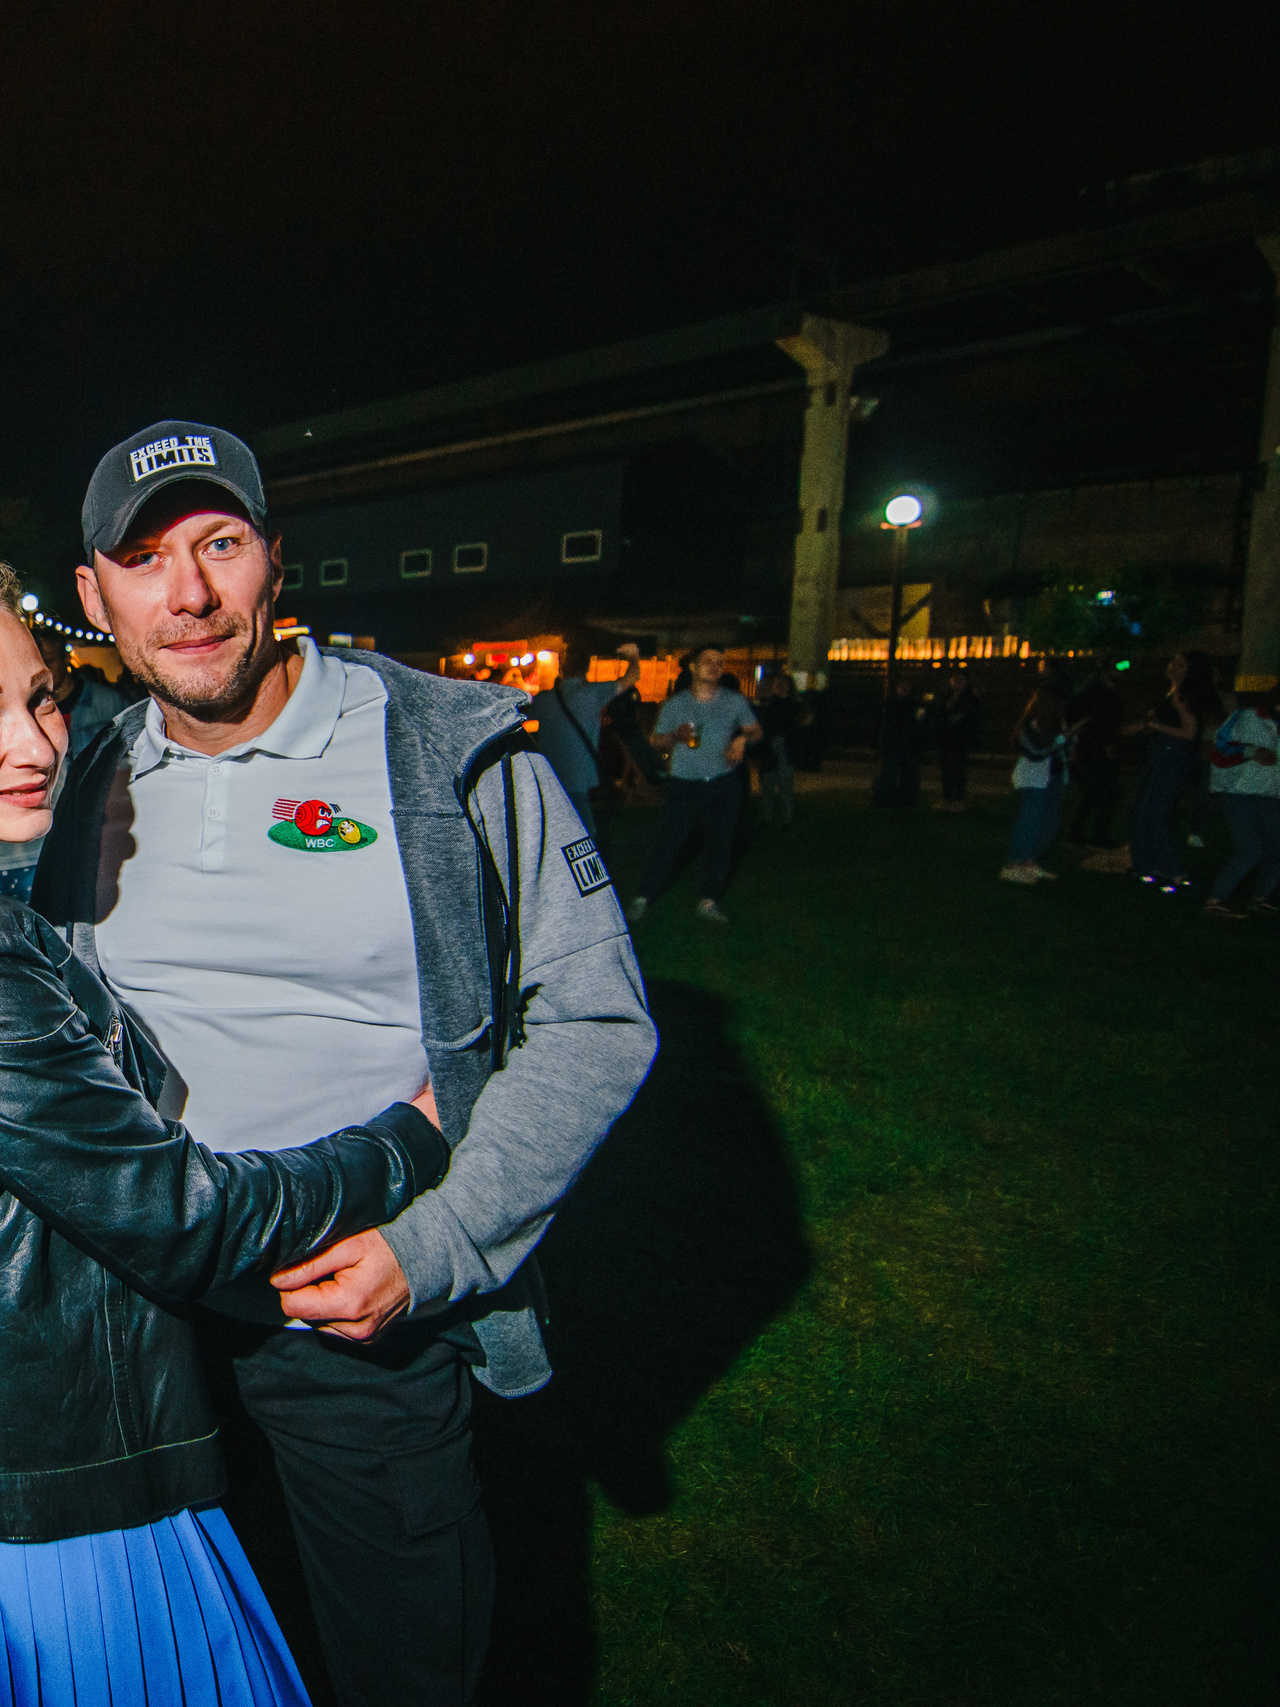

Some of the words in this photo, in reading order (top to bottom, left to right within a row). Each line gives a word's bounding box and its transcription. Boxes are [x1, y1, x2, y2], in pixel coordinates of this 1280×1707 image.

[130, 437, 179, 460] EXCEED
[185, 436, 211, 447] THE
[135, 447, 212, 477] LIMITS
[305, 838, 334, 849] WBC
